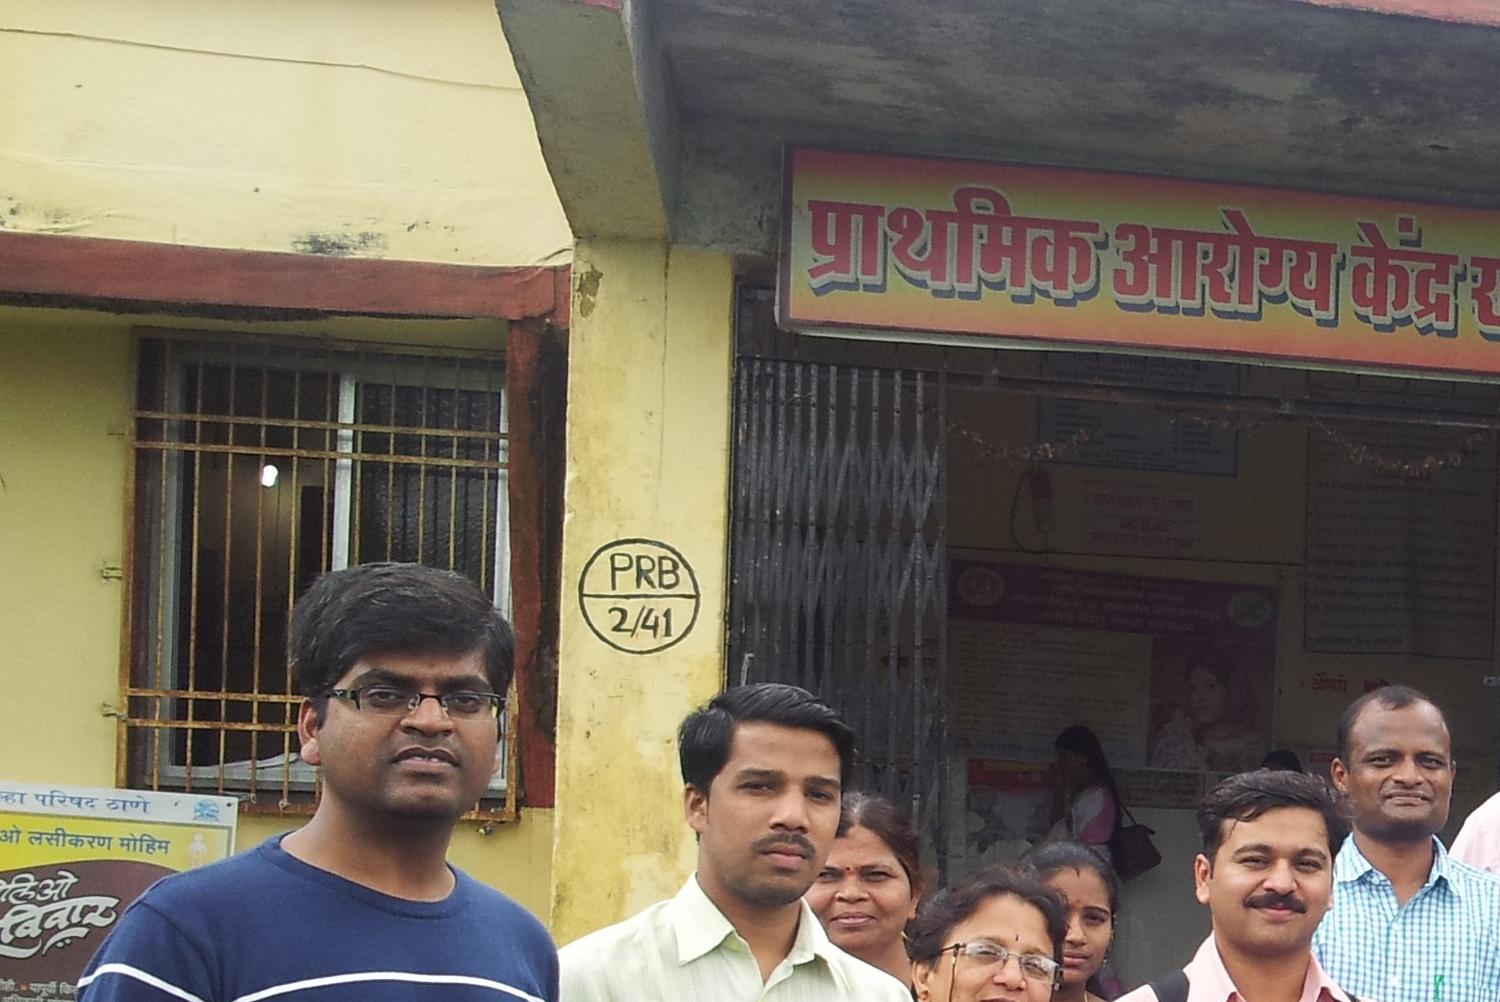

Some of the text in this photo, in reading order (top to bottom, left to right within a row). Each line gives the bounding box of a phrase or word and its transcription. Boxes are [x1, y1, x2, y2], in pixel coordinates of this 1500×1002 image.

[807, 185, 1107, 305] प्राथमिक
[1113, 207, 1345, 328] आरोग्य
[1349, 214, 1463, 336] केंद्र
[609, 552, 680, 591] PRB
[608, 605, 673, 639] 2/41
[34, 789, 99, 811] परिषद
[106, 795, 152, 813] ठाणे
[28, 827, 114, 851] लसीकरण
[119, 832, 172, 855] मोहिम
